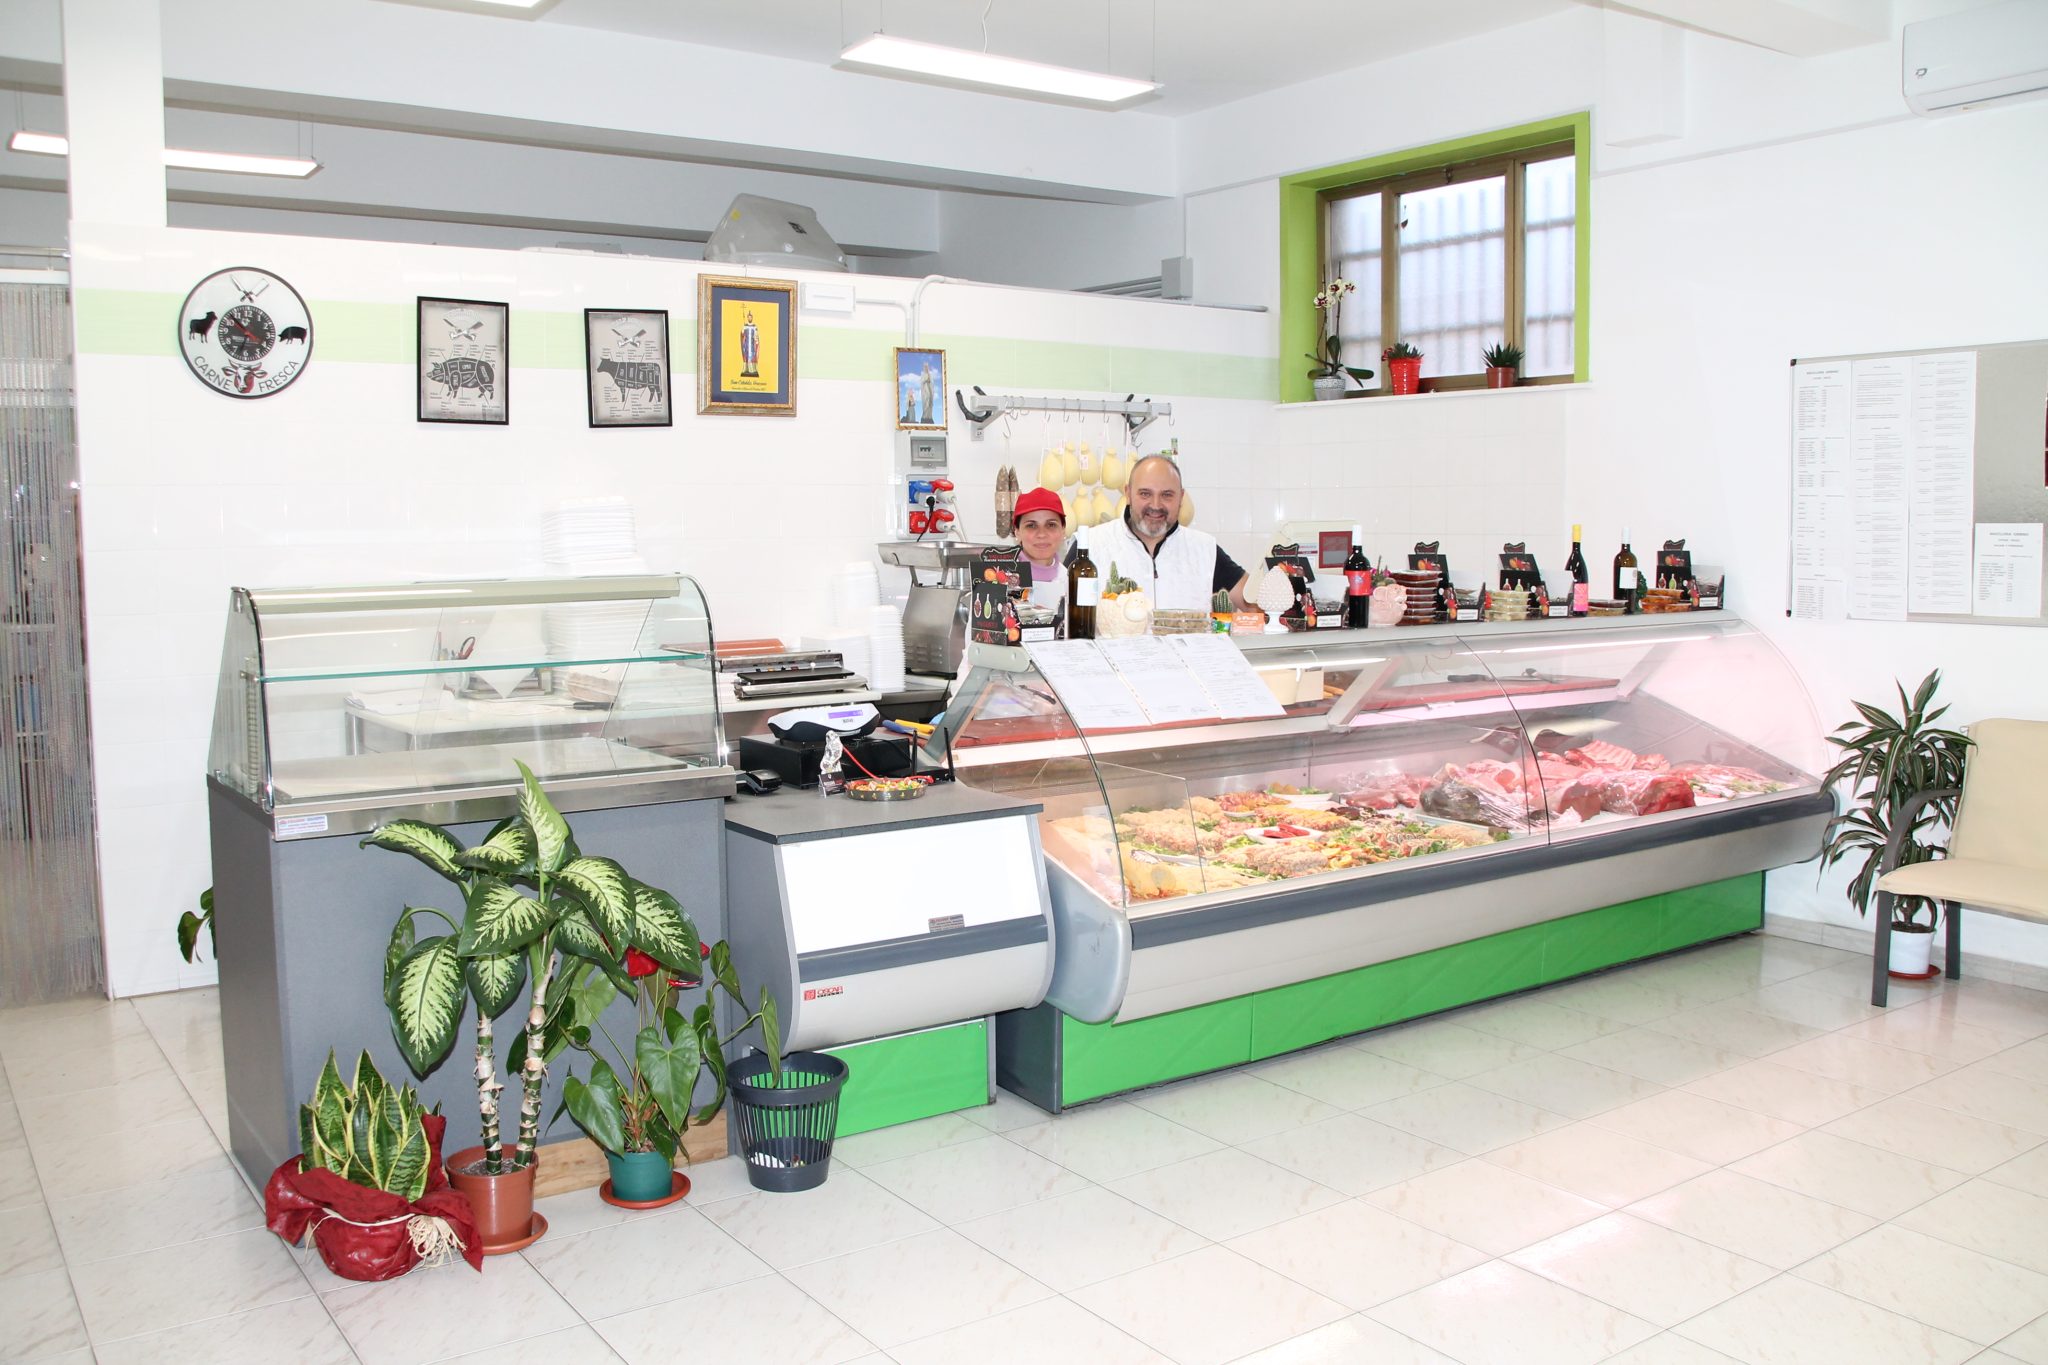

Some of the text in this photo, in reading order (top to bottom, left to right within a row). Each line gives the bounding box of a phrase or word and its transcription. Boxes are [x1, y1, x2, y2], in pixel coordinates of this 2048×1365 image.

[244, 310, 253, 318] 12
[226, 319, 235, 327] 10
[263, 322, 269, 330] 2
[225, 337, 231, 345] 8
[232, 345, 238, 353] 7
[243, 349, 249, 357] 6
[194, 355, 300, 392] CARNE FRESCA
